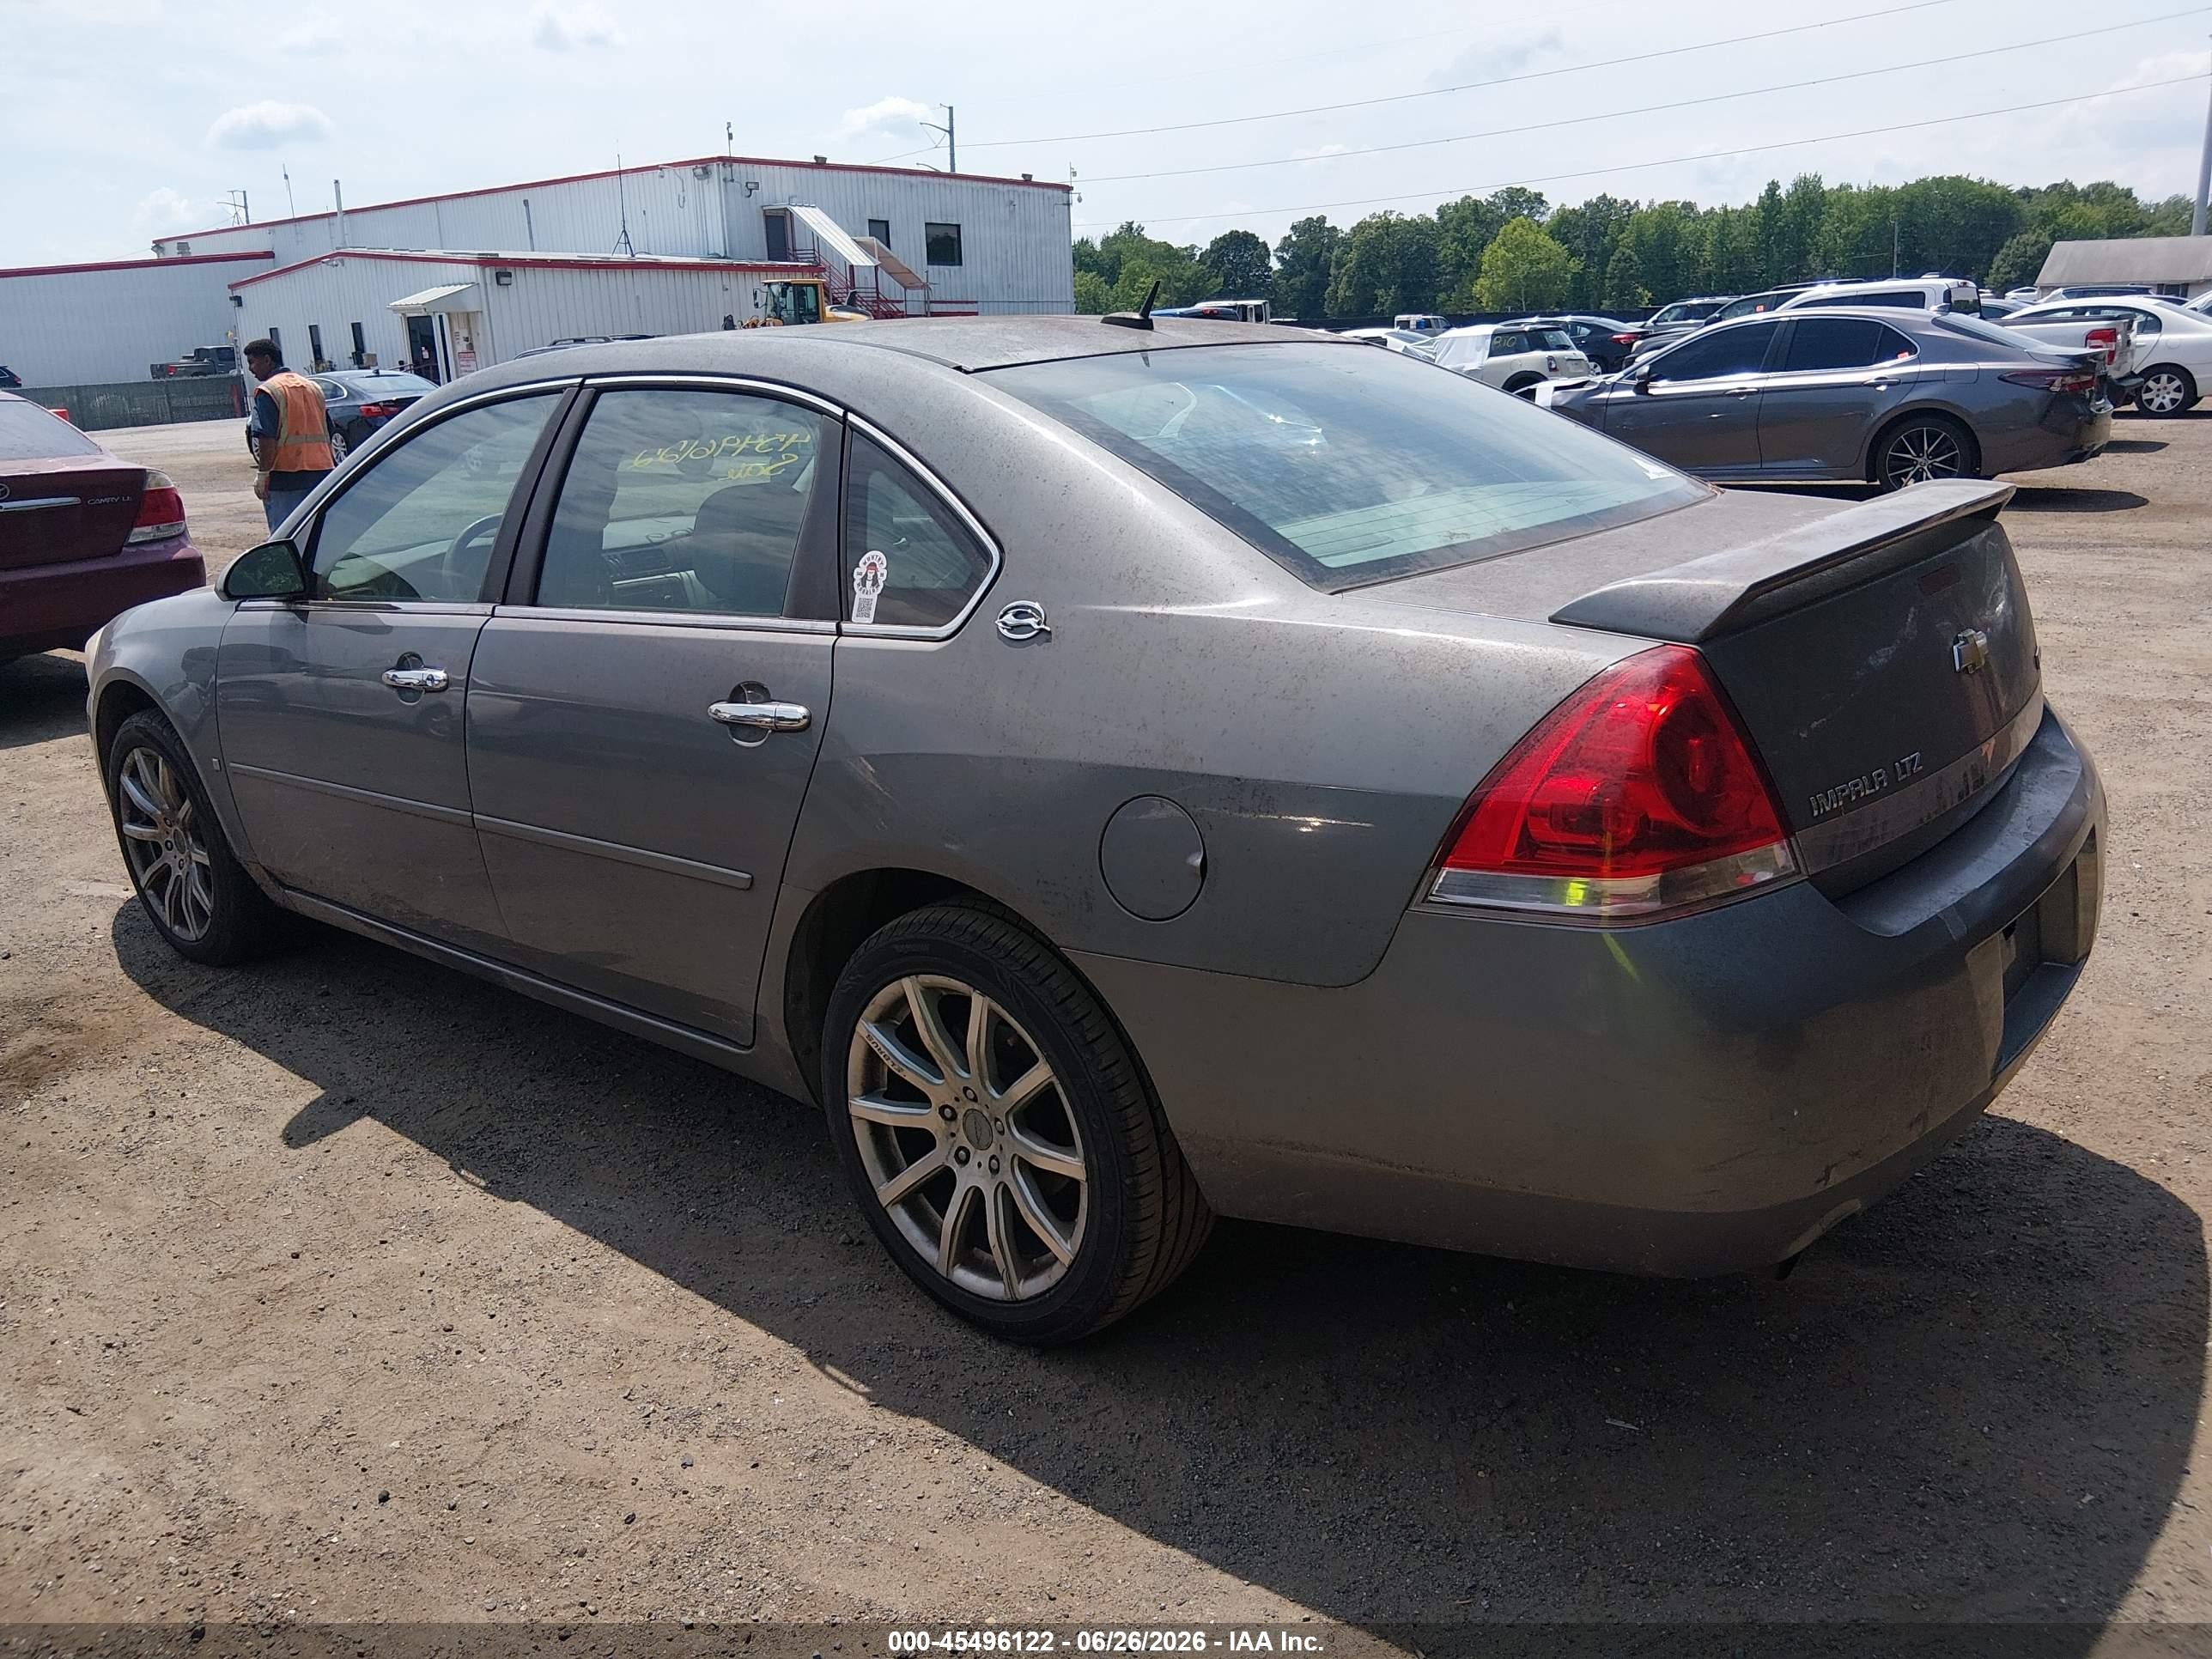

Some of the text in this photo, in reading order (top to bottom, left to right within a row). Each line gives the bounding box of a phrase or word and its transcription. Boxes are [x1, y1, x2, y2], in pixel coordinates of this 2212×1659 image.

[87, 496, 119, 505] CAMRY
[1809, 752, 1923, 817] IMPALA LTZ
